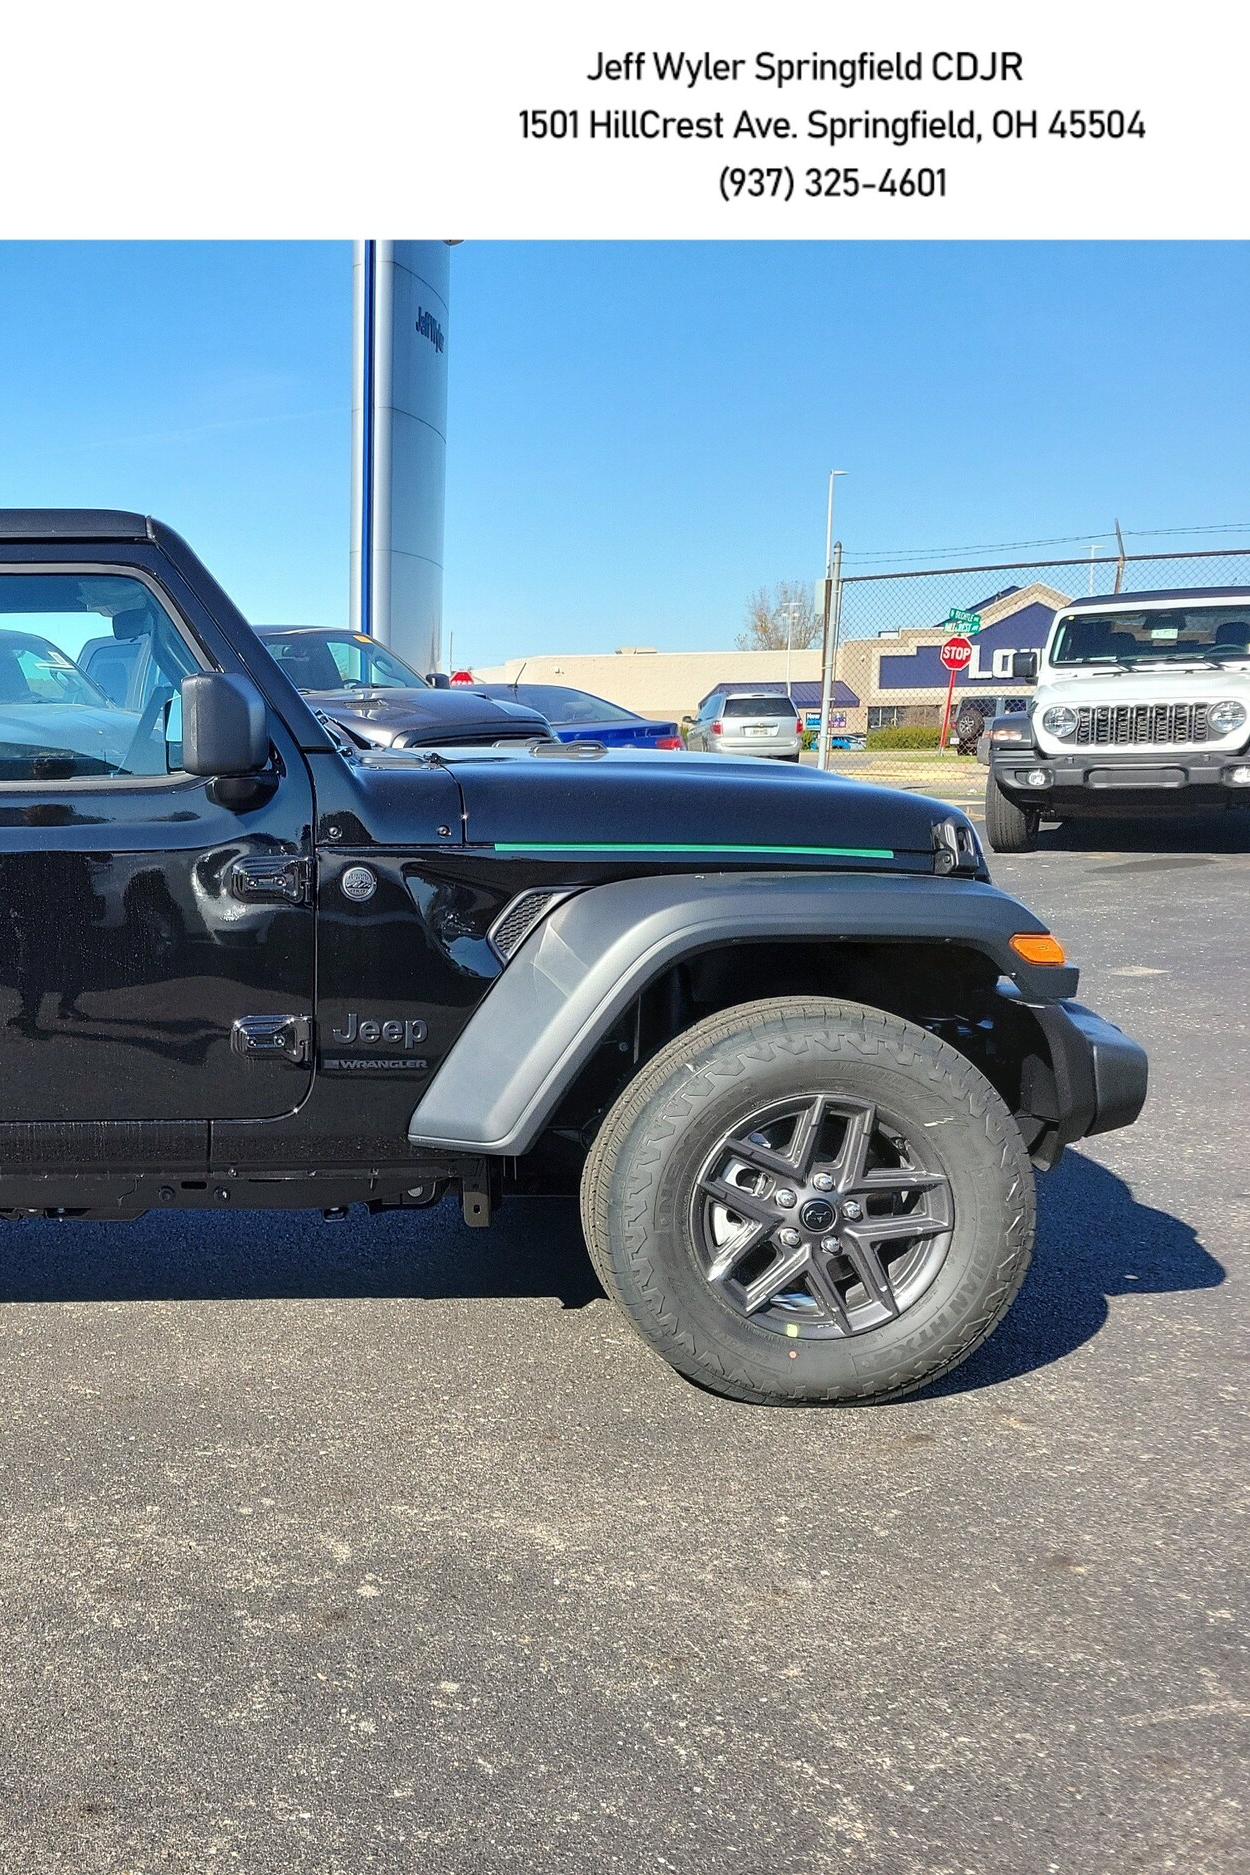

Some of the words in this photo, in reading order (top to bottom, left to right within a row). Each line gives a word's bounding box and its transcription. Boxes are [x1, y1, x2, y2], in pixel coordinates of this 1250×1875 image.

[943, 646, 971, 661] STOP
[332, 1013, 428, 1049] Jeep
[338, 1060, 429, 1070] WRANGLER
